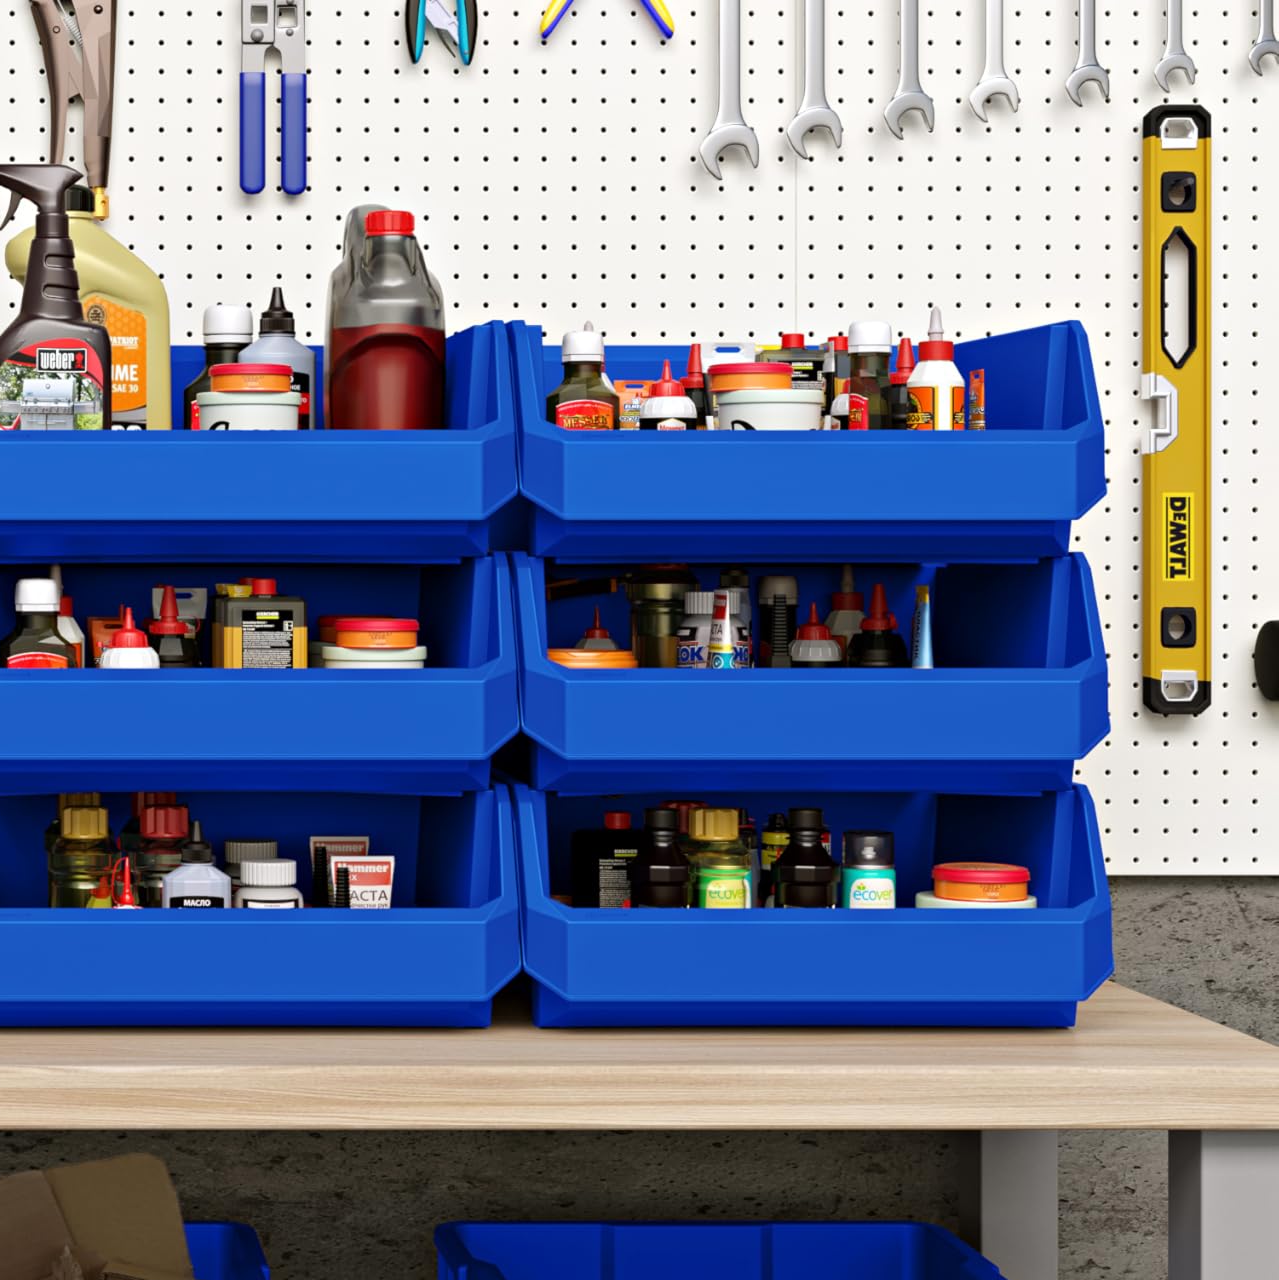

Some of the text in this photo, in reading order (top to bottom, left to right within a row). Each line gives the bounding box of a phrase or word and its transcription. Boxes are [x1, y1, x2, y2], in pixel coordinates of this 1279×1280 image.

[40, 350, 76, 369] weber
[111, 364, 139, 381] IME
[1169, 496, 1187, 579] DEWALT
[183, 899, 212, 907] МАСЛО
[350, 890, 389, 901] АСТА
